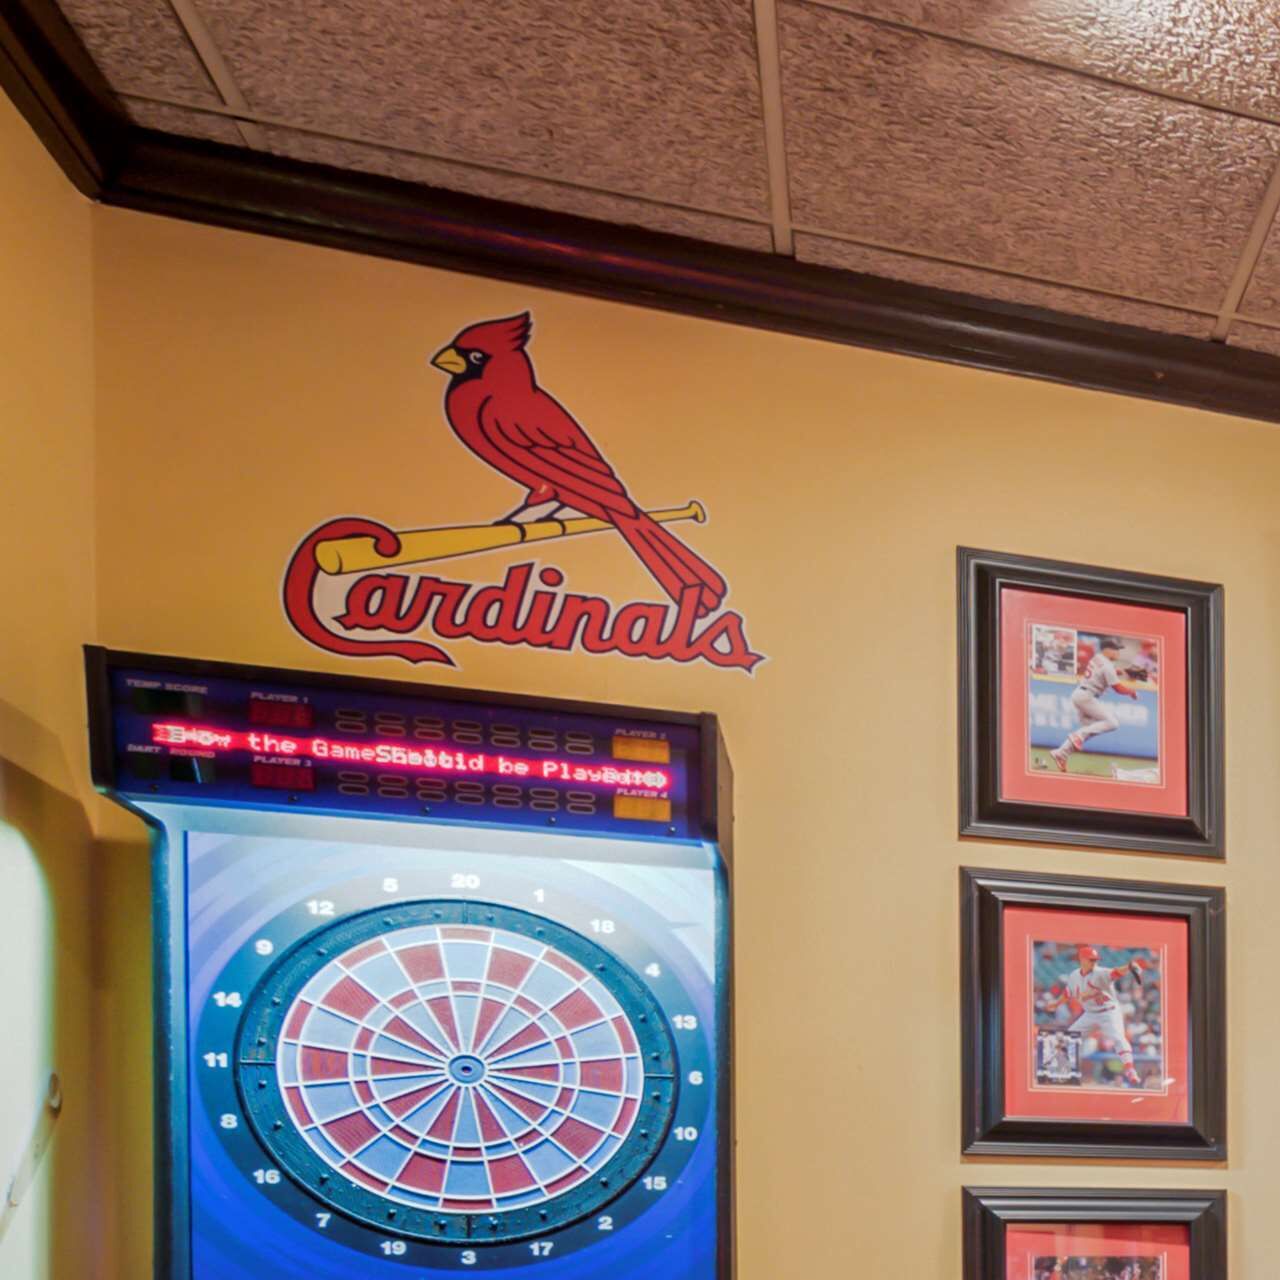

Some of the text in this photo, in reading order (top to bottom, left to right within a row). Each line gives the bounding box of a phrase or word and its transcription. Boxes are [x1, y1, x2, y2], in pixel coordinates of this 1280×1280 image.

[283, 518, 766, 673] Cardinals
[164, 682, 208, 695] SCORE
[251, 691, 300, 703] PLAYER
[614, 728, 656, 739] PLAYER
[249, 731, 298, 755] the
[498, 757, 529, 775] be
[253, 755, 302, 768] PLAYER
[616, 787, 657, 799] PLAYER
[382, 877, 398, 892] 5
[451, 873, 480, 889] 20
[534, 889, 544, 903] 1
[307, 901, 334, 915] 12
[591, 920, 614, 933] 18
[257, 941, 272, 955] 9
[645, 963, 660, 977] 4
[214, 993, 241, 1007] 14
[672, 1016, 697, 1029] 13
[204, 1053, 227, 1066] 11
[689, 1071, 702, 1084] 6
[221, 1114, 237, 1128] 8
[674, 1128, 697, 1141] 10
[254, 1170, 280, 1185] 16
[643, 1177, 667, 1190] 15
[317, 1214, 331, 1227] 7
[598, 1216, 612, 1229] 2
[381, 1241, 407, 1255] 19
[530, 1242, 553, 1255] 17
[461, 1251, 475, 1264] 3
